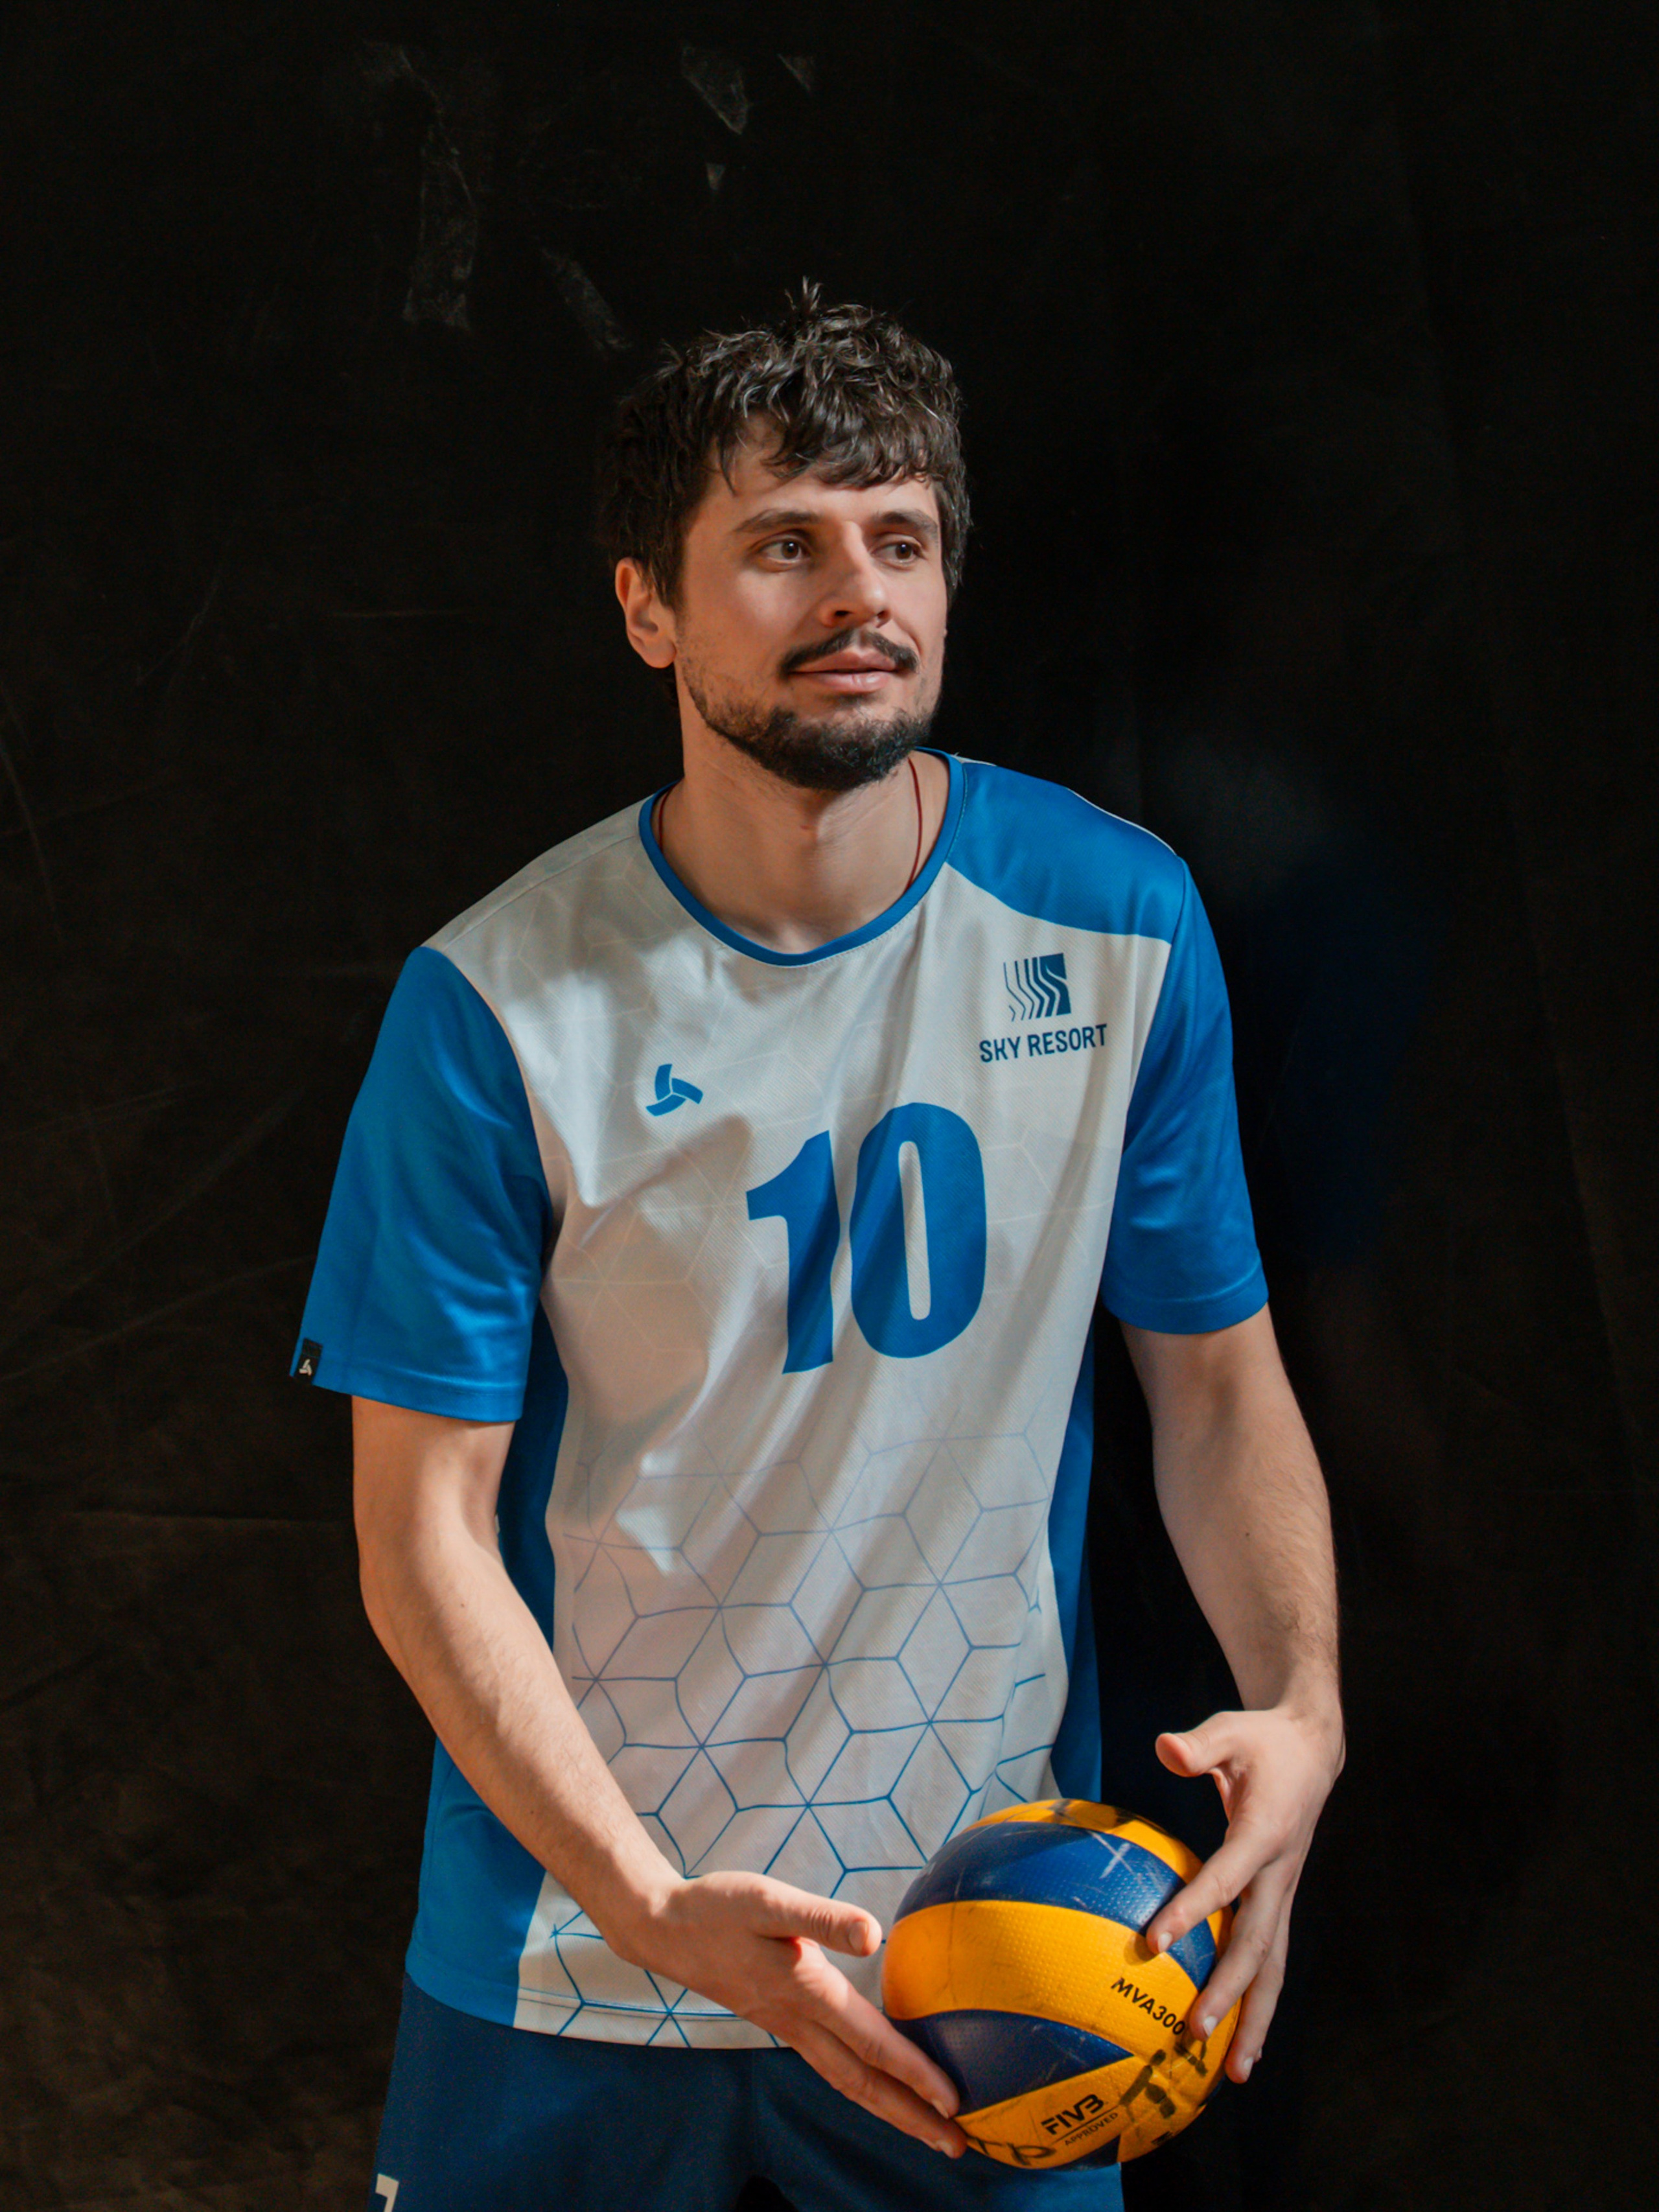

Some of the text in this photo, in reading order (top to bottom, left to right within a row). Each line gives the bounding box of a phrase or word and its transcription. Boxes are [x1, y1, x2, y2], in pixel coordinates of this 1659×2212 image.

[979, 1023, 1107, 1063] SKY RESORT
[747, 1102, 986, 1373] 10
[1111, 1977, 1185, 2035] MVA300
[1065, 2112, 1119, 2146] APPROVED
